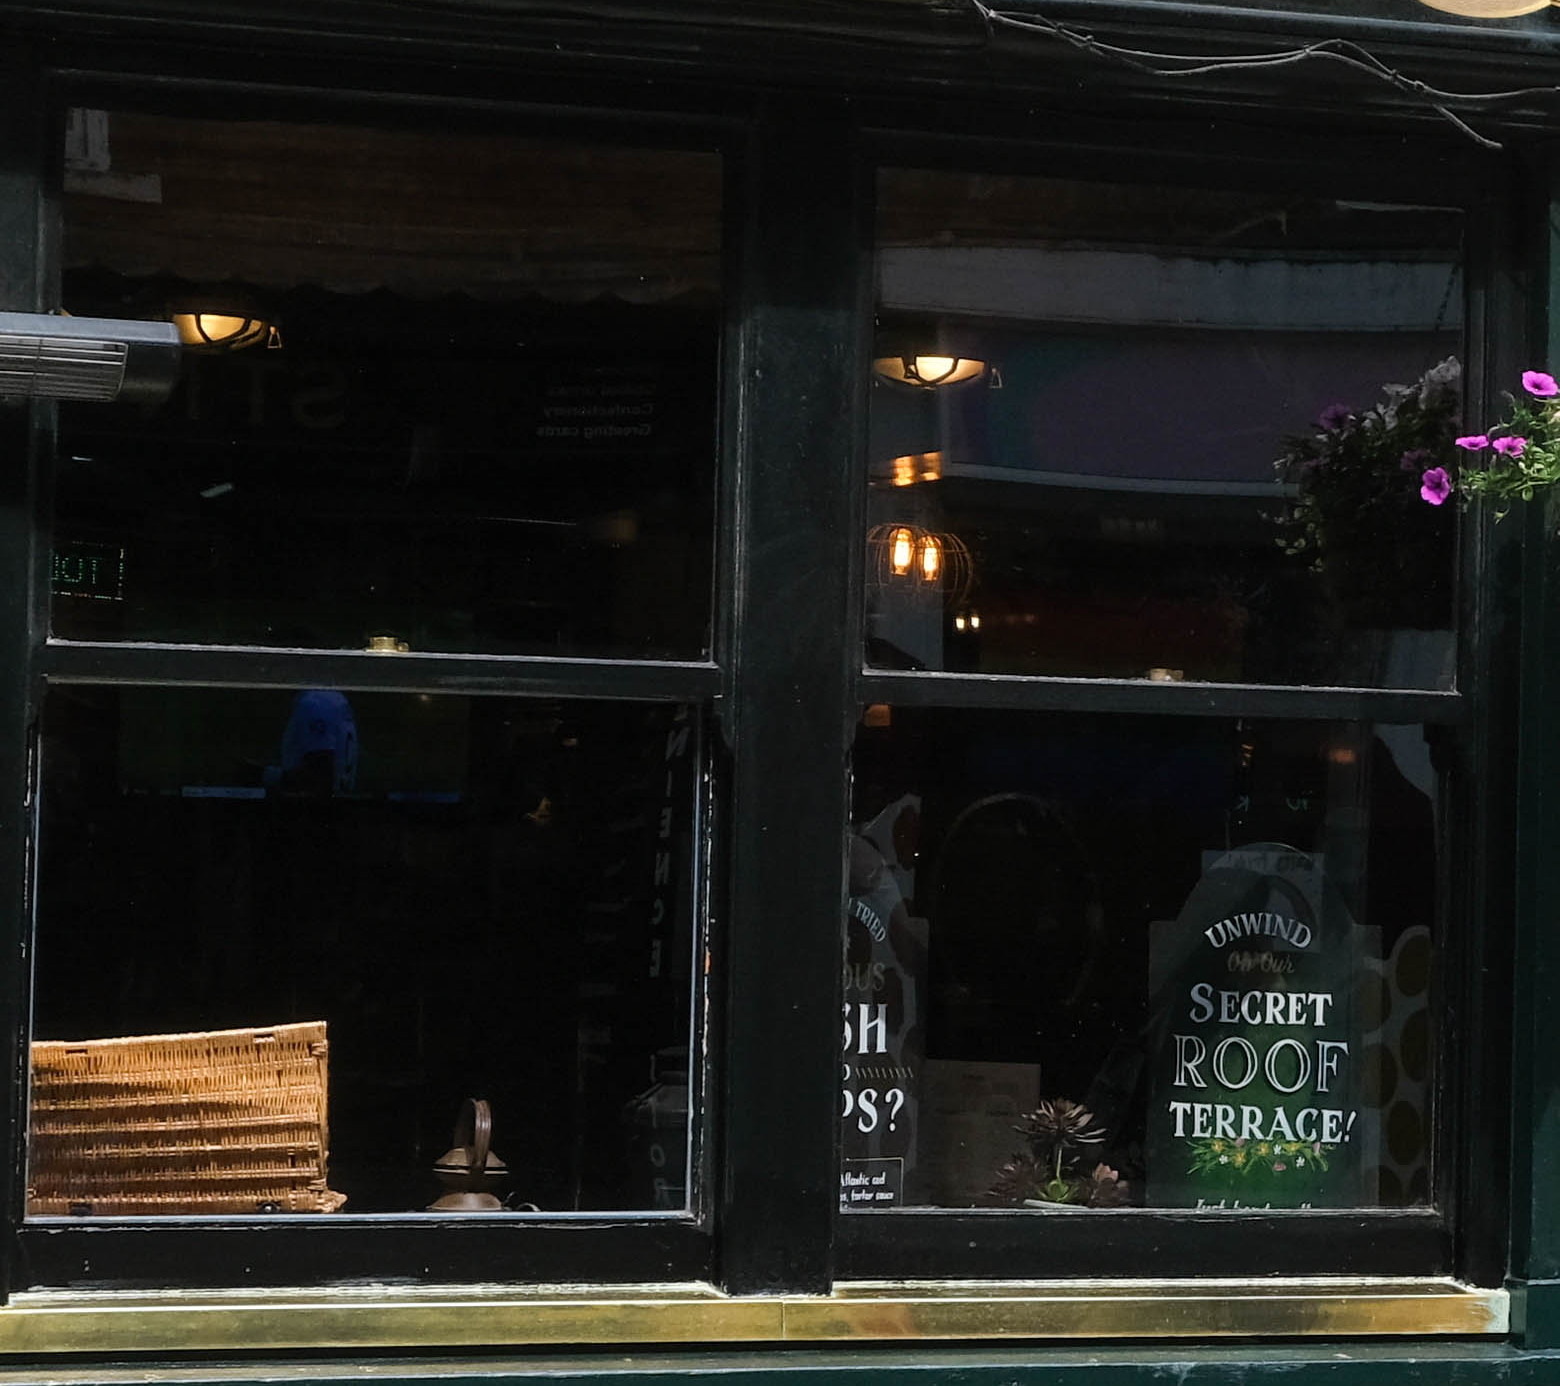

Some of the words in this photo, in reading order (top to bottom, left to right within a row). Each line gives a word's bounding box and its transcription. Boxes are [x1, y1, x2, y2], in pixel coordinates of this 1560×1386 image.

[856, 899, 887, 943] TRIED
[1204, 912, 1313, 949] UNWIND
[1189, 981, 1334, 1027] SECRET
[1172, 1033, 1351, 1093] ROOF
[1168, 1100, 1358, 1144] TERRACE!
